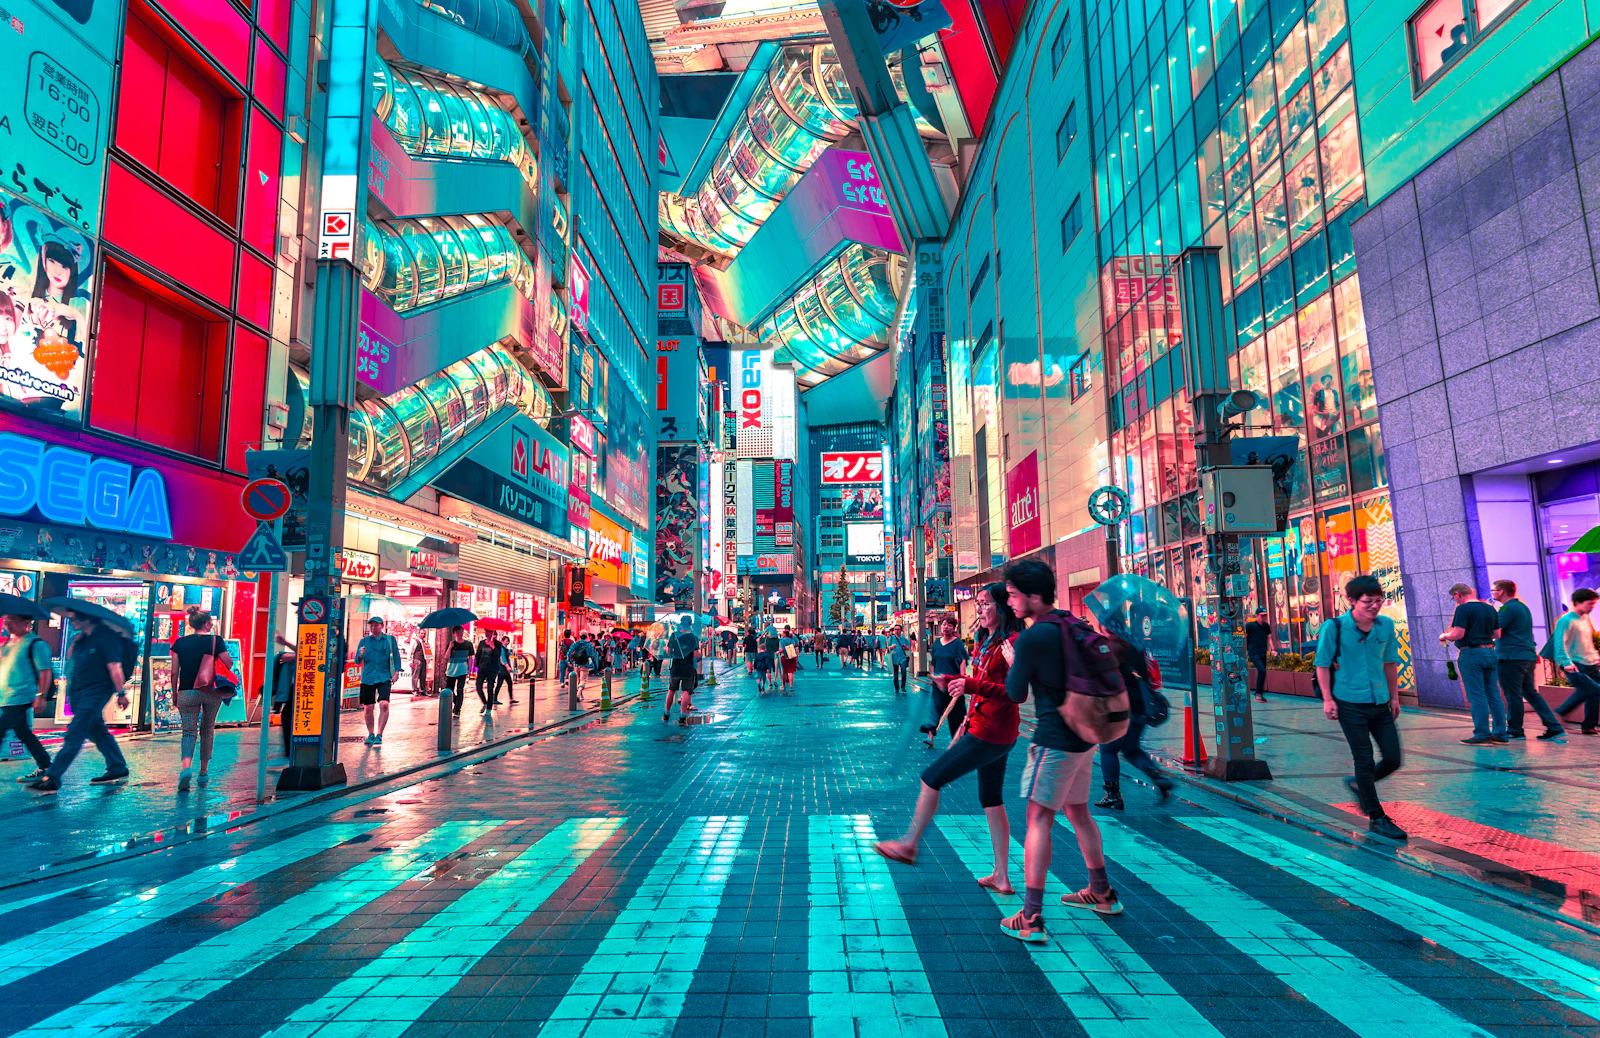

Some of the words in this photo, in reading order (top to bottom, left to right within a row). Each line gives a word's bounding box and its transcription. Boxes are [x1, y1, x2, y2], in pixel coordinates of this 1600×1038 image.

[39, 74, 90, 123] 16:00
[43, 62, 89, 105] 営業時間
[32, 112, 88, 159] 翌5:00
[0, 163, 90, 230] らです。
[321, 242, 329, 258] AK
[359, 331, 390, 363] カメラ
[532, 438, 567, 491] LABI
[780, 463, 791, 485] Duty
[0, 432, 173, 540] SEGA
[500, 484, 543, 525] パソコン館
[532, 476, 567, 506] AKIHABARA
[781, 486, 791, 508] Free
[1012, 486, 1034, 527] atré
[419, 552, 437, 567] LABI
[300, 632, 318, 732] 路上喫煙禁止です。
[347, 666, 363, 677] au
[297, 735, 320, 743] 千代田区
